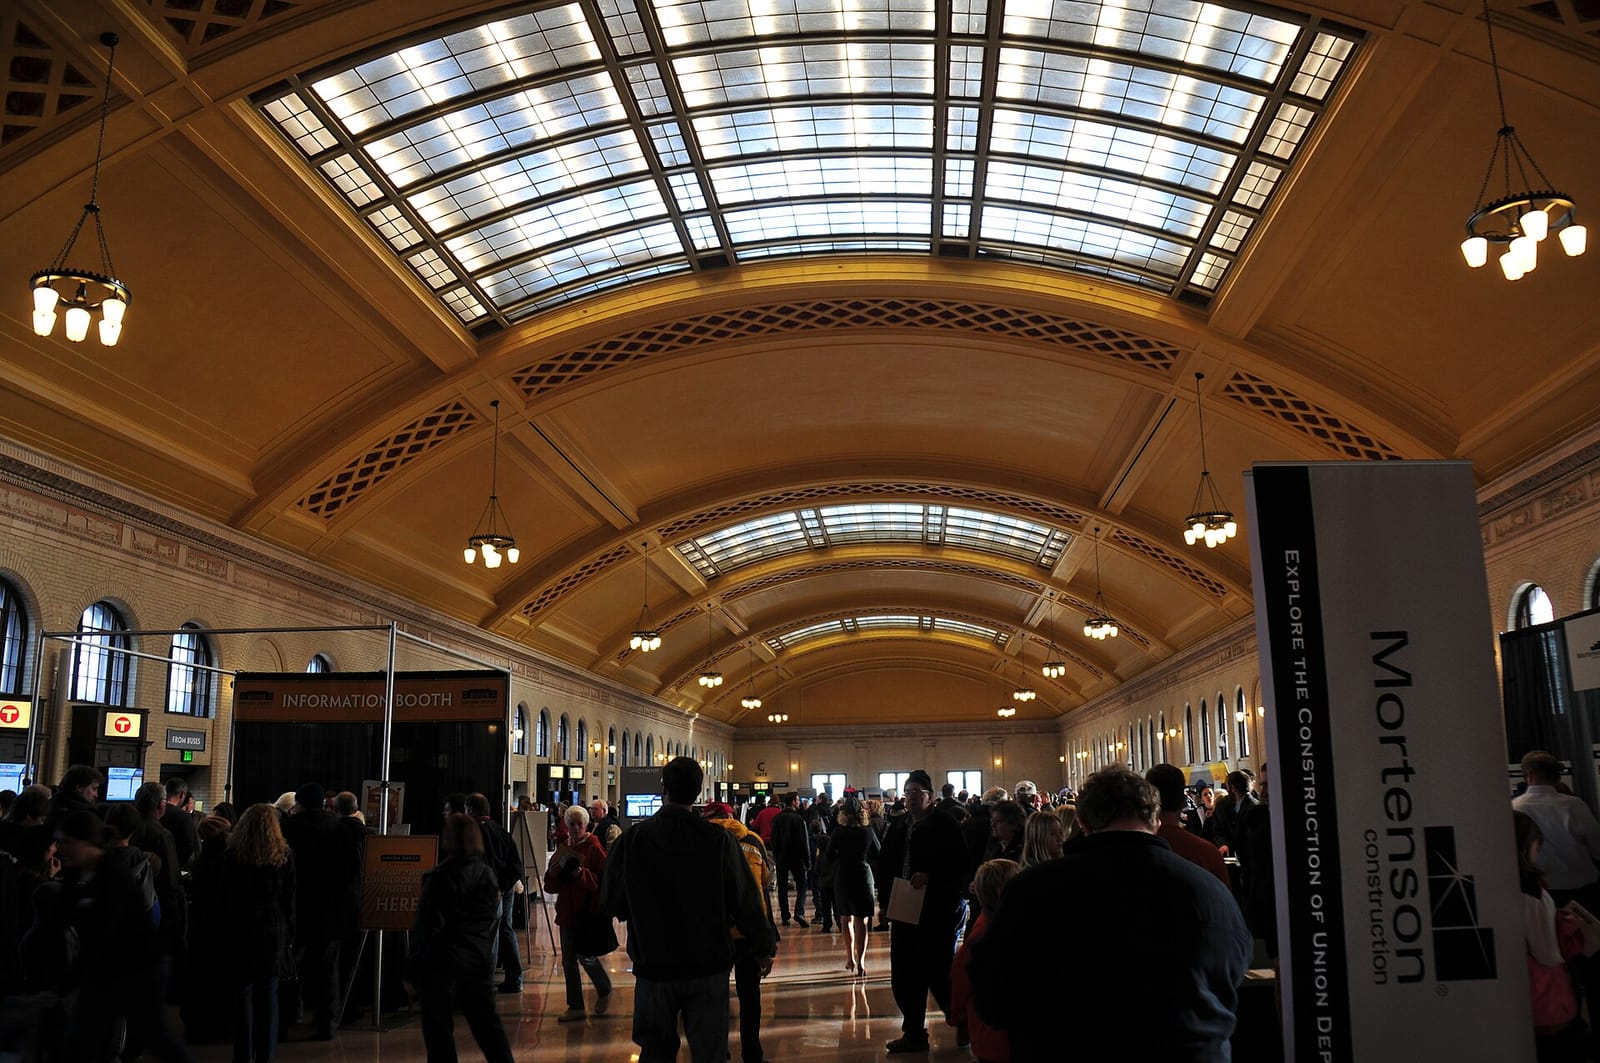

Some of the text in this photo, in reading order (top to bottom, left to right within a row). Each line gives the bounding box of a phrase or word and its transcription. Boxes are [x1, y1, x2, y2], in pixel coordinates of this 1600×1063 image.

[1285, 549, 1305, 651] EXPLORE
[282, 693, 387, 708] INFORMATION
[395, 692, 452, 707] BOOTH
[1293, 656, 1309, 700] THE
[171, 735, 201, 746] FROM BUSES
[757, 761, 766, 772] C
[1298, 707, 1322, 886] CONSTRUCTION
[1370, 630, 1426, 984] Mortenson
[376, 896, 419, 912] HERE
[1311, 893, 1325, 925] OF
[1363, 828, 1389, 985] construction
[1313, 932, 1329, 1007] UNION
